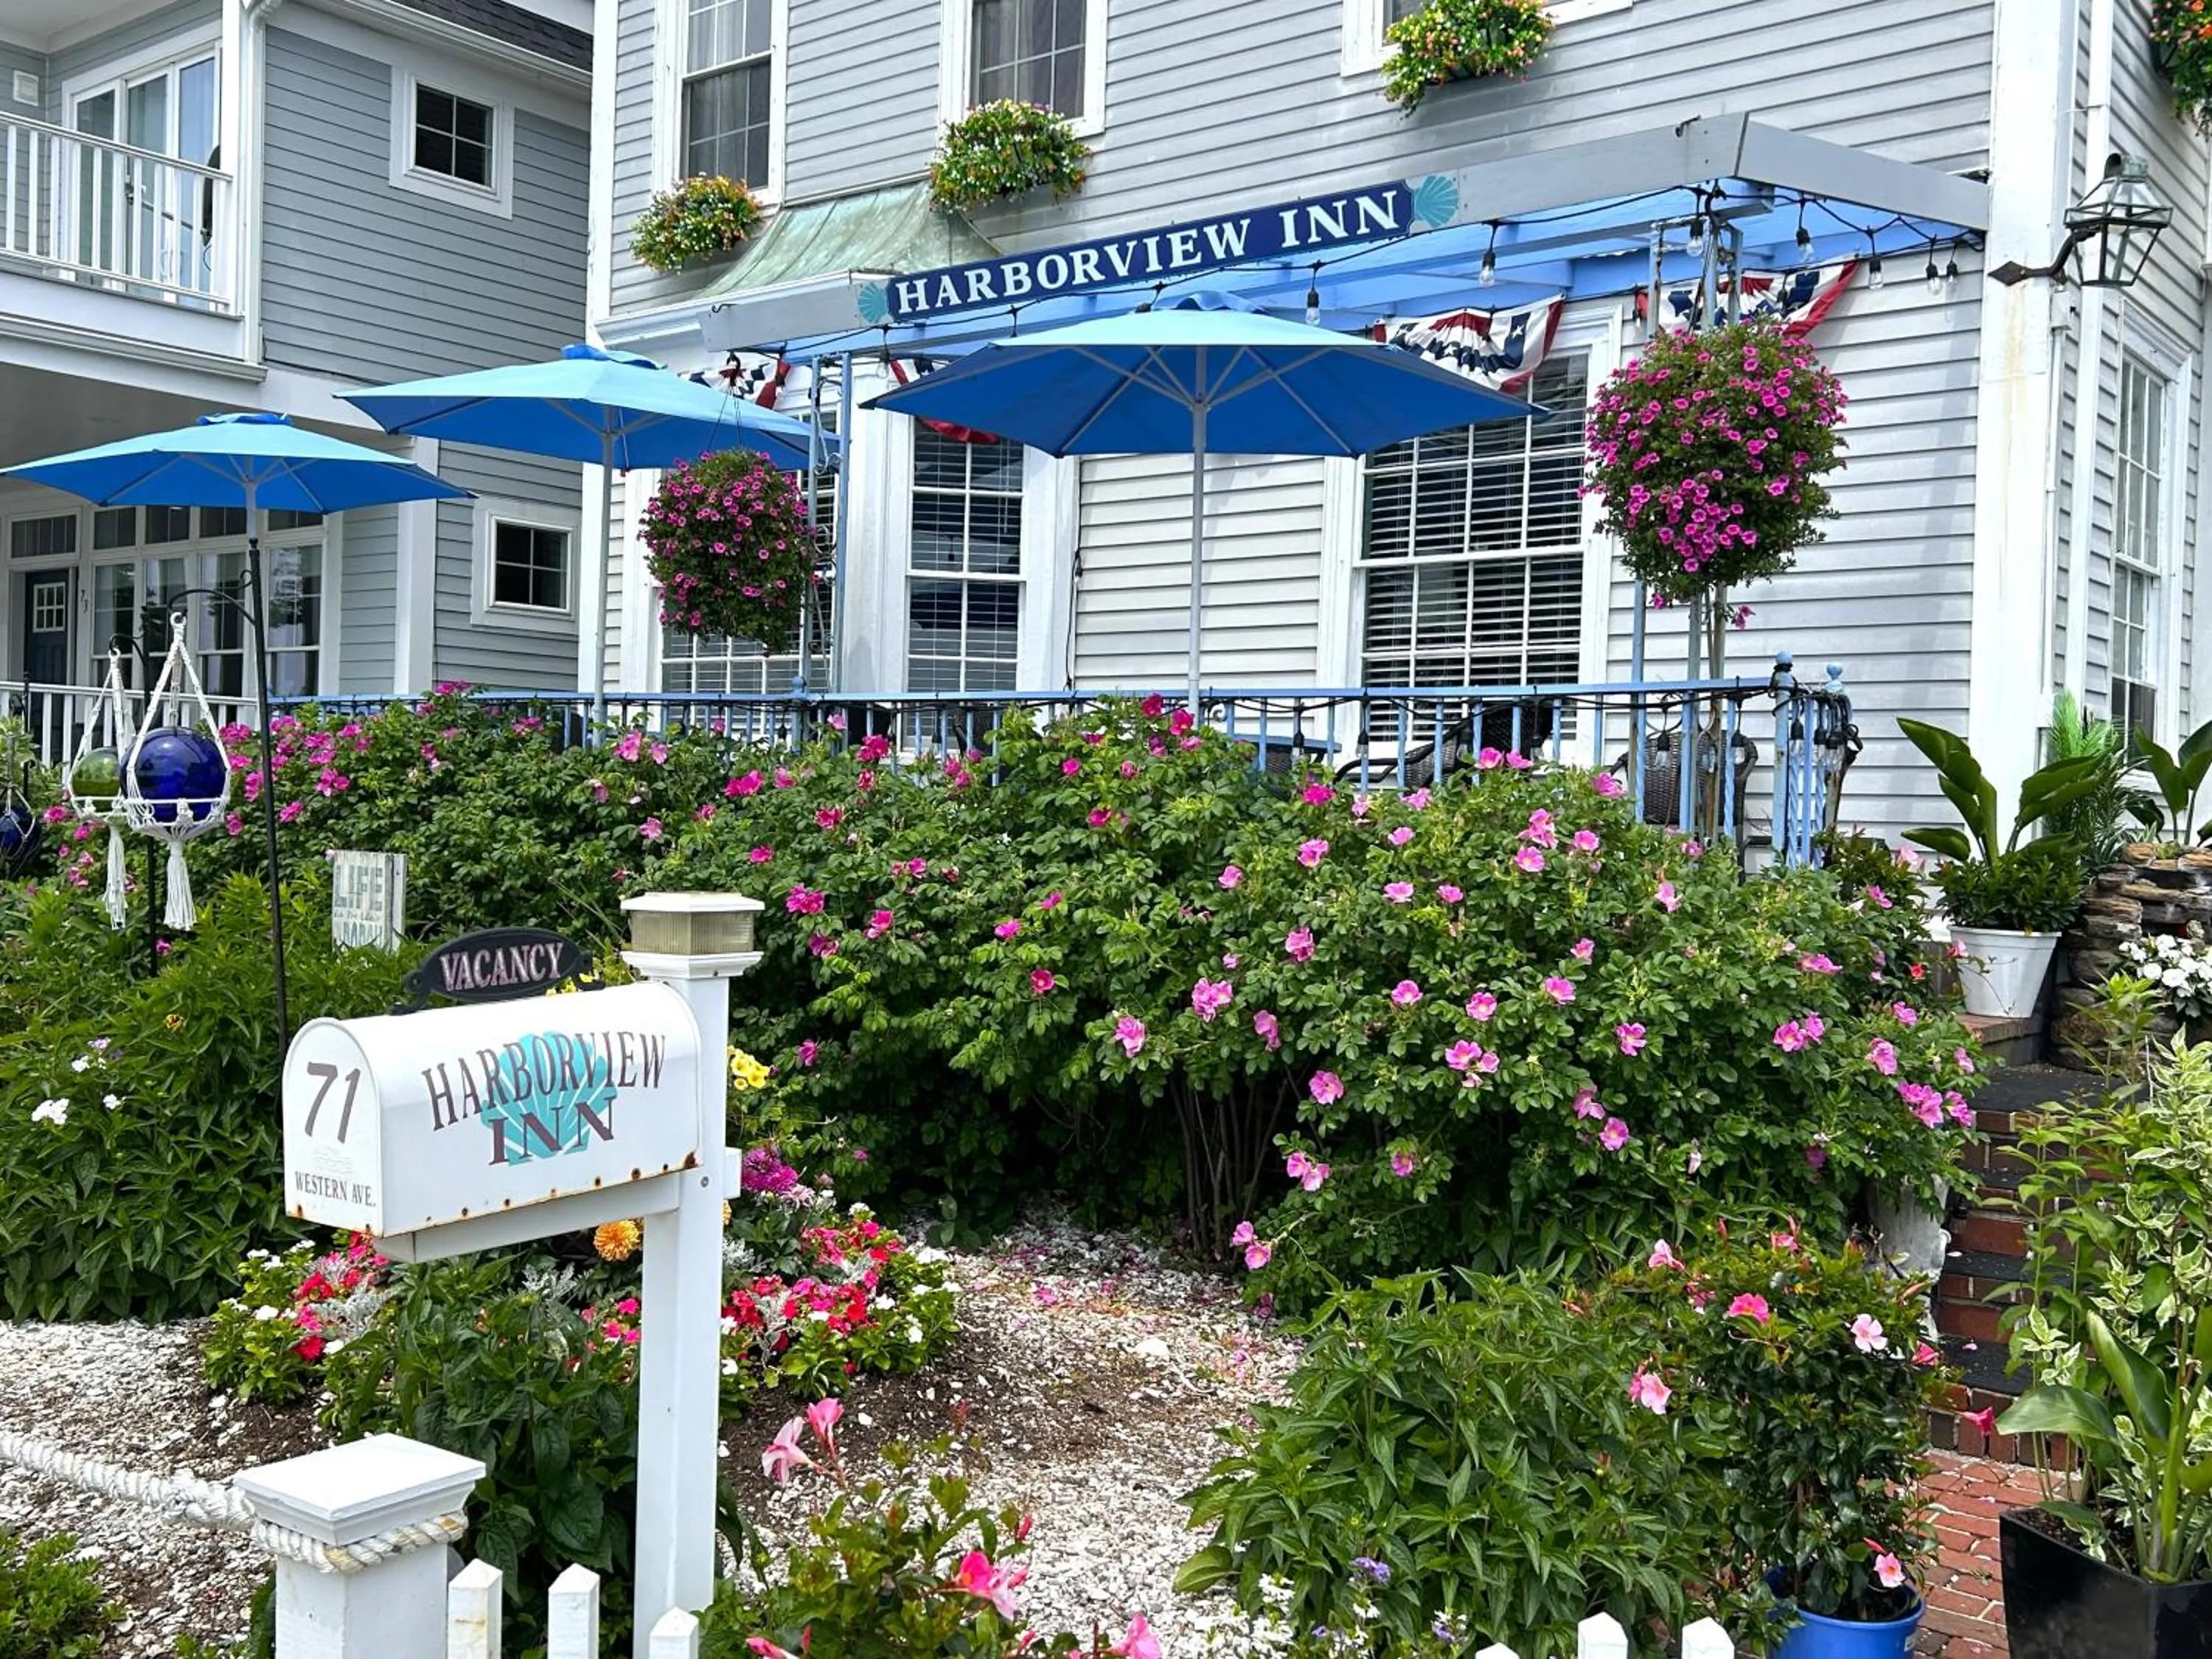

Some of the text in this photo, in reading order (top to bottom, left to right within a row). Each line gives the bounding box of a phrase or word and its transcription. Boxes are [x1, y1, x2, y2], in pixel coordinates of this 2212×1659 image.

[895, 189, 1399, 313] HARBORVIEW INN
[334, 865, 383, 911] LIFE
[439, 942, 563, 991] VACANCY
[305, 1062, 361, 1144] 71
[421, 1031, 666, 1131] HARBORVIEW
[488, 1096, 614, 1166] INN
[294, 1170, 377, 1207] WESTERN AVE.
